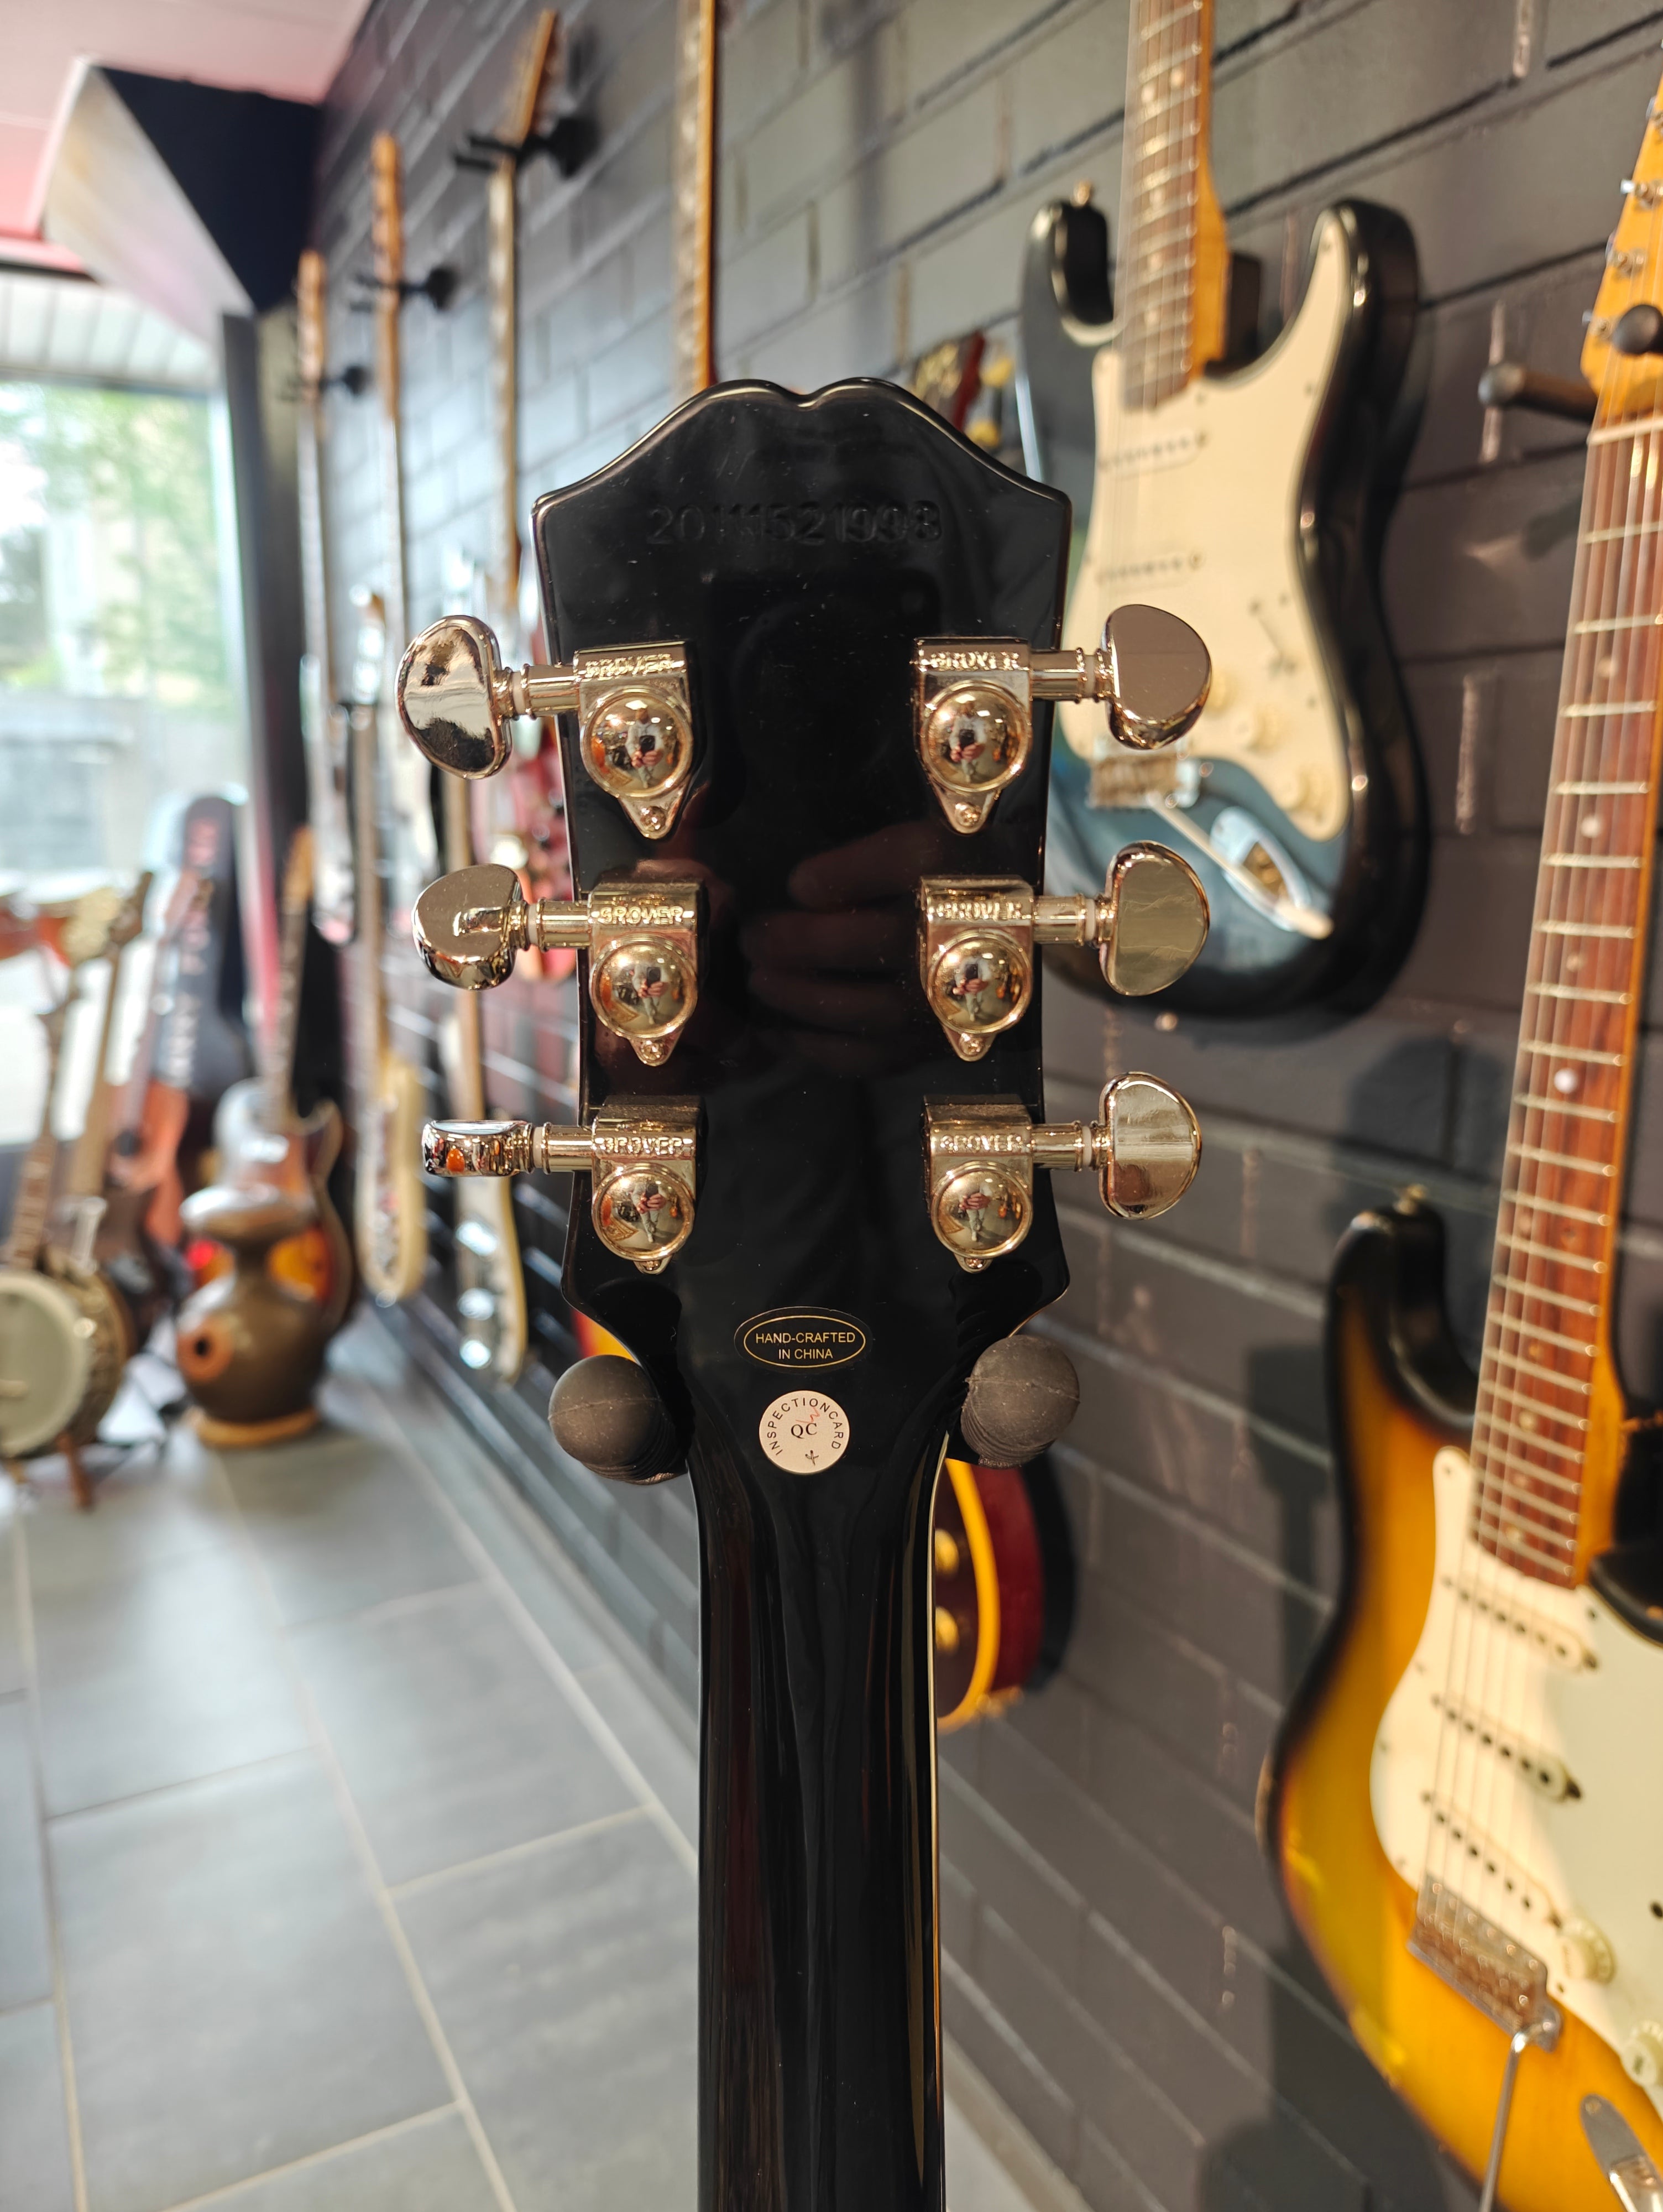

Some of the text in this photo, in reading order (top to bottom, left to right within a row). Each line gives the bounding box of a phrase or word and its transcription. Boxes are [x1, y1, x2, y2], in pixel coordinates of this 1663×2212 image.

[599, 905, 684, 924] GROVER
[940, 1134, 1023, 1152] GROVER
[755, 1332, 856, 1344] HAND-CRAFTED
[778, 1348, 833, 1359] IN CHINA
[791, 1423, 817, 1439] QC
